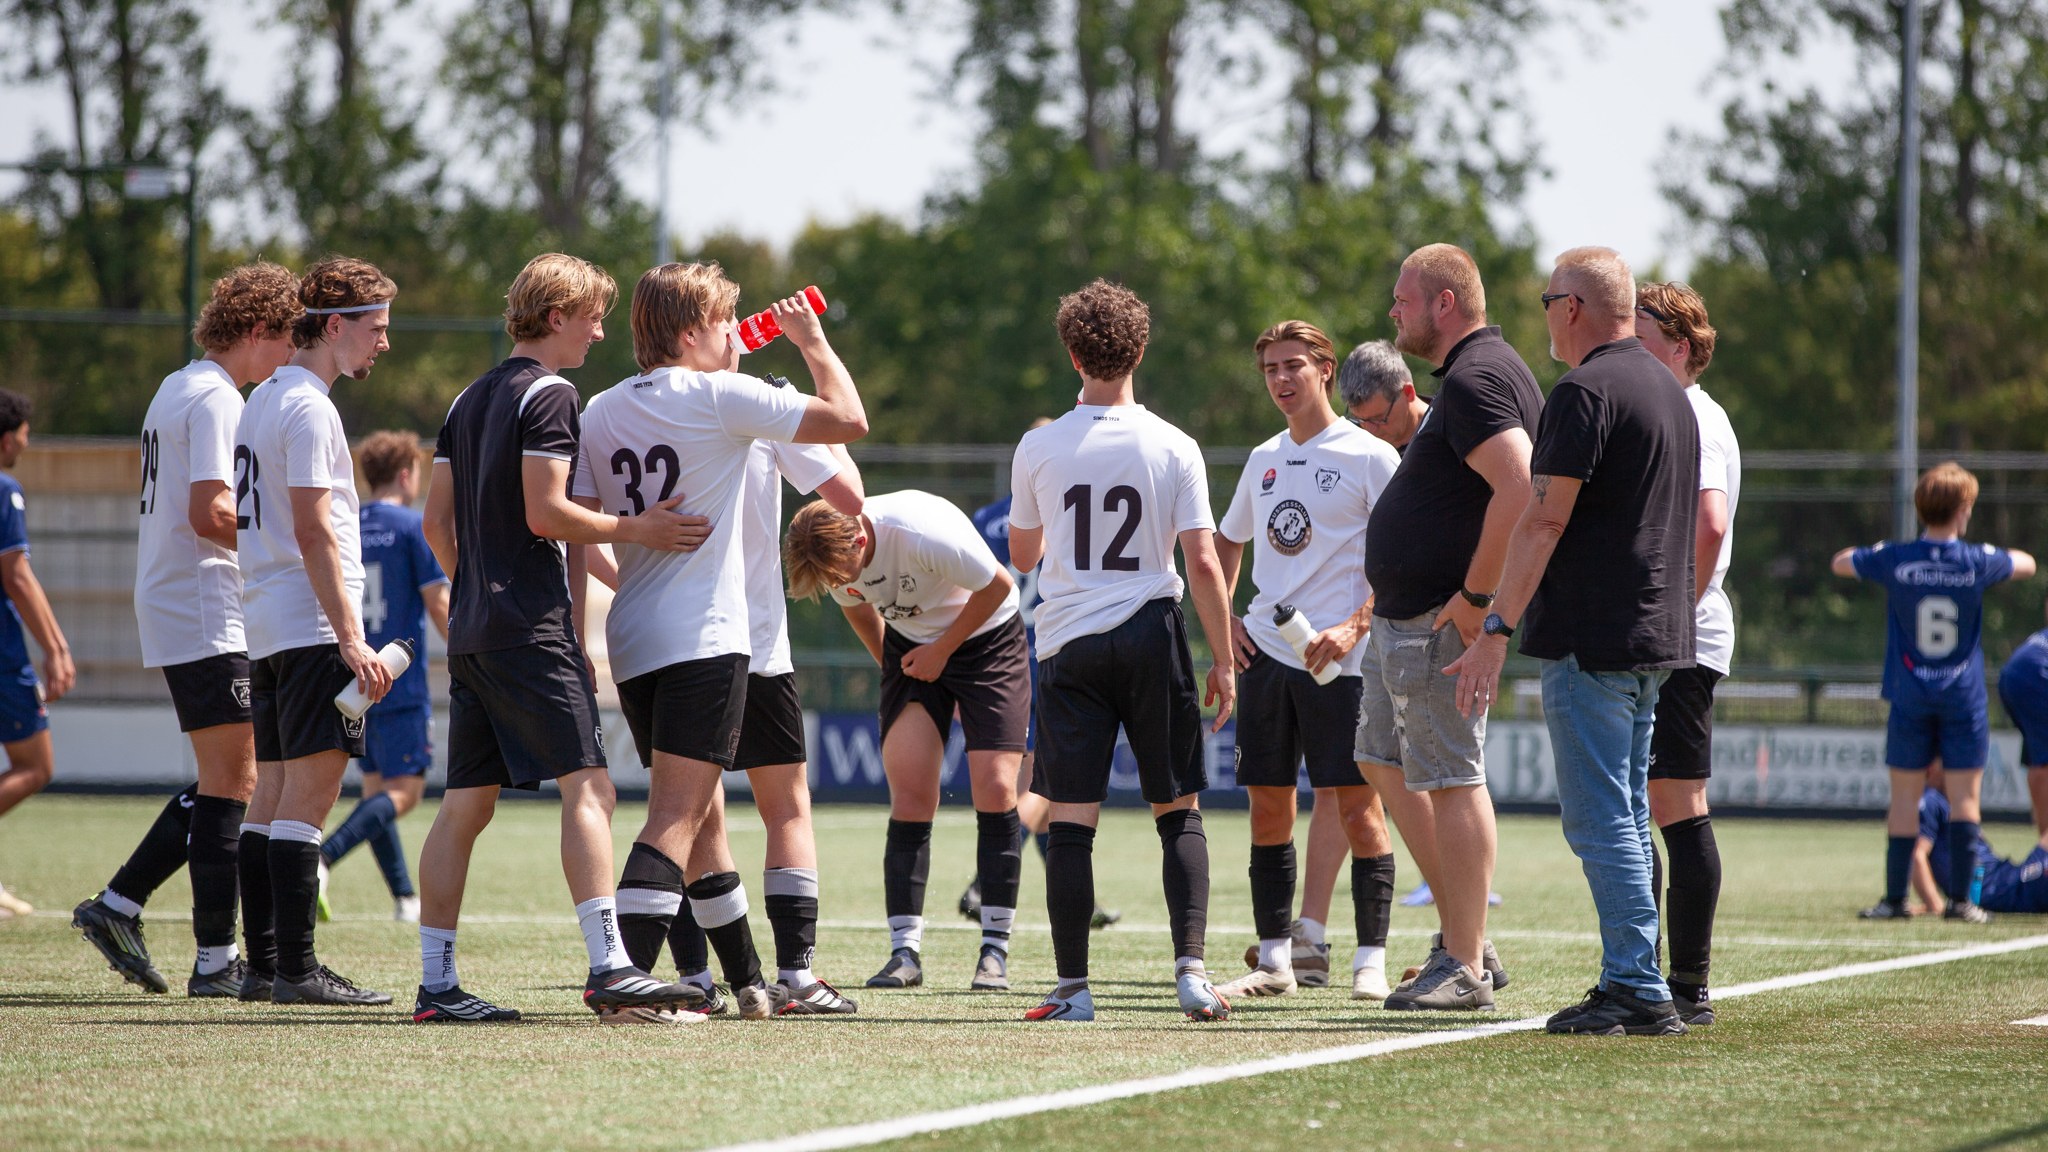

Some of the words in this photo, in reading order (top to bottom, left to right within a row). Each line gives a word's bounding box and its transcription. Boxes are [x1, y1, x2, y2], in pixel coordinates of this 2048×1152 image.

[140, 428, 159, 514] 29
[611, 444, 681, 516] 32
[1064, 484, 1142, 571] 12
[1916, 594, 1959, 660] 6
